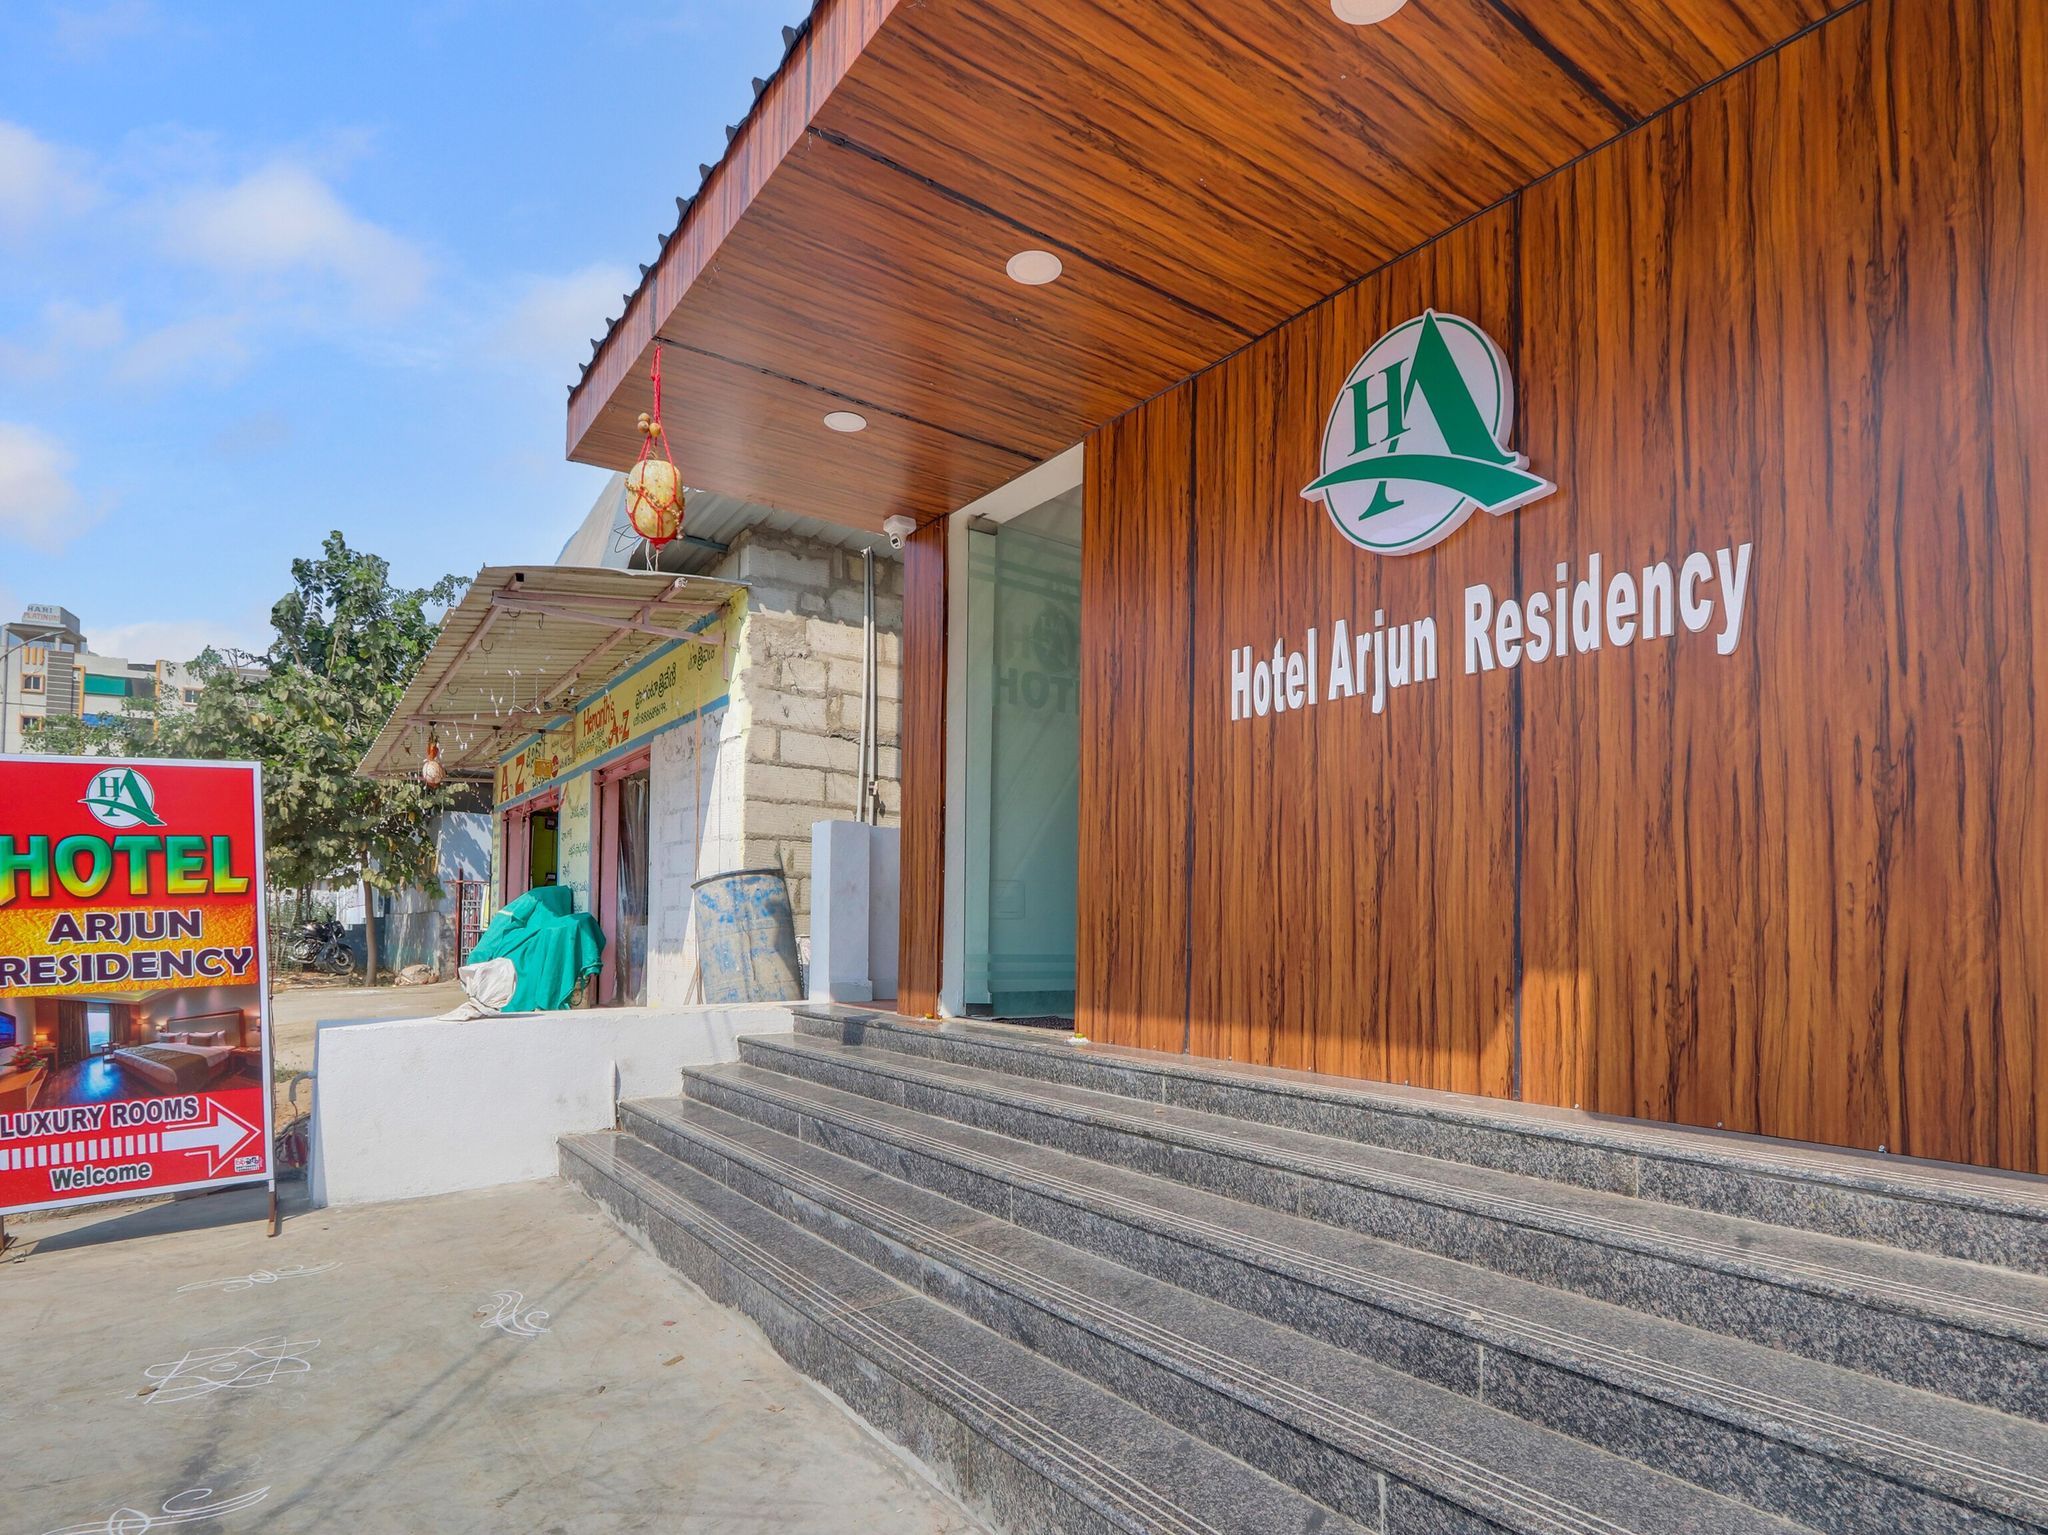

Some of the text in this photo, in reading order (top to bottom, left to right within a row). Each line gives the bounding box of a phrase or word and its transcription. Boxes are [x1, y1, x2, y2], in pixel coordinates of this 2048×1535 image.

[1230, 543, 1754, 722] Hotel Arjun Residency
[0, 834, 249, 903] HOTEL
[47, 910, 203, 945] ARJUN
[0, 946, 254, 986] RESIDENCY
[1, 1095, 200, 1139] LUXURY ROOMS
[52, 1161, 153, 1191] Welcome
